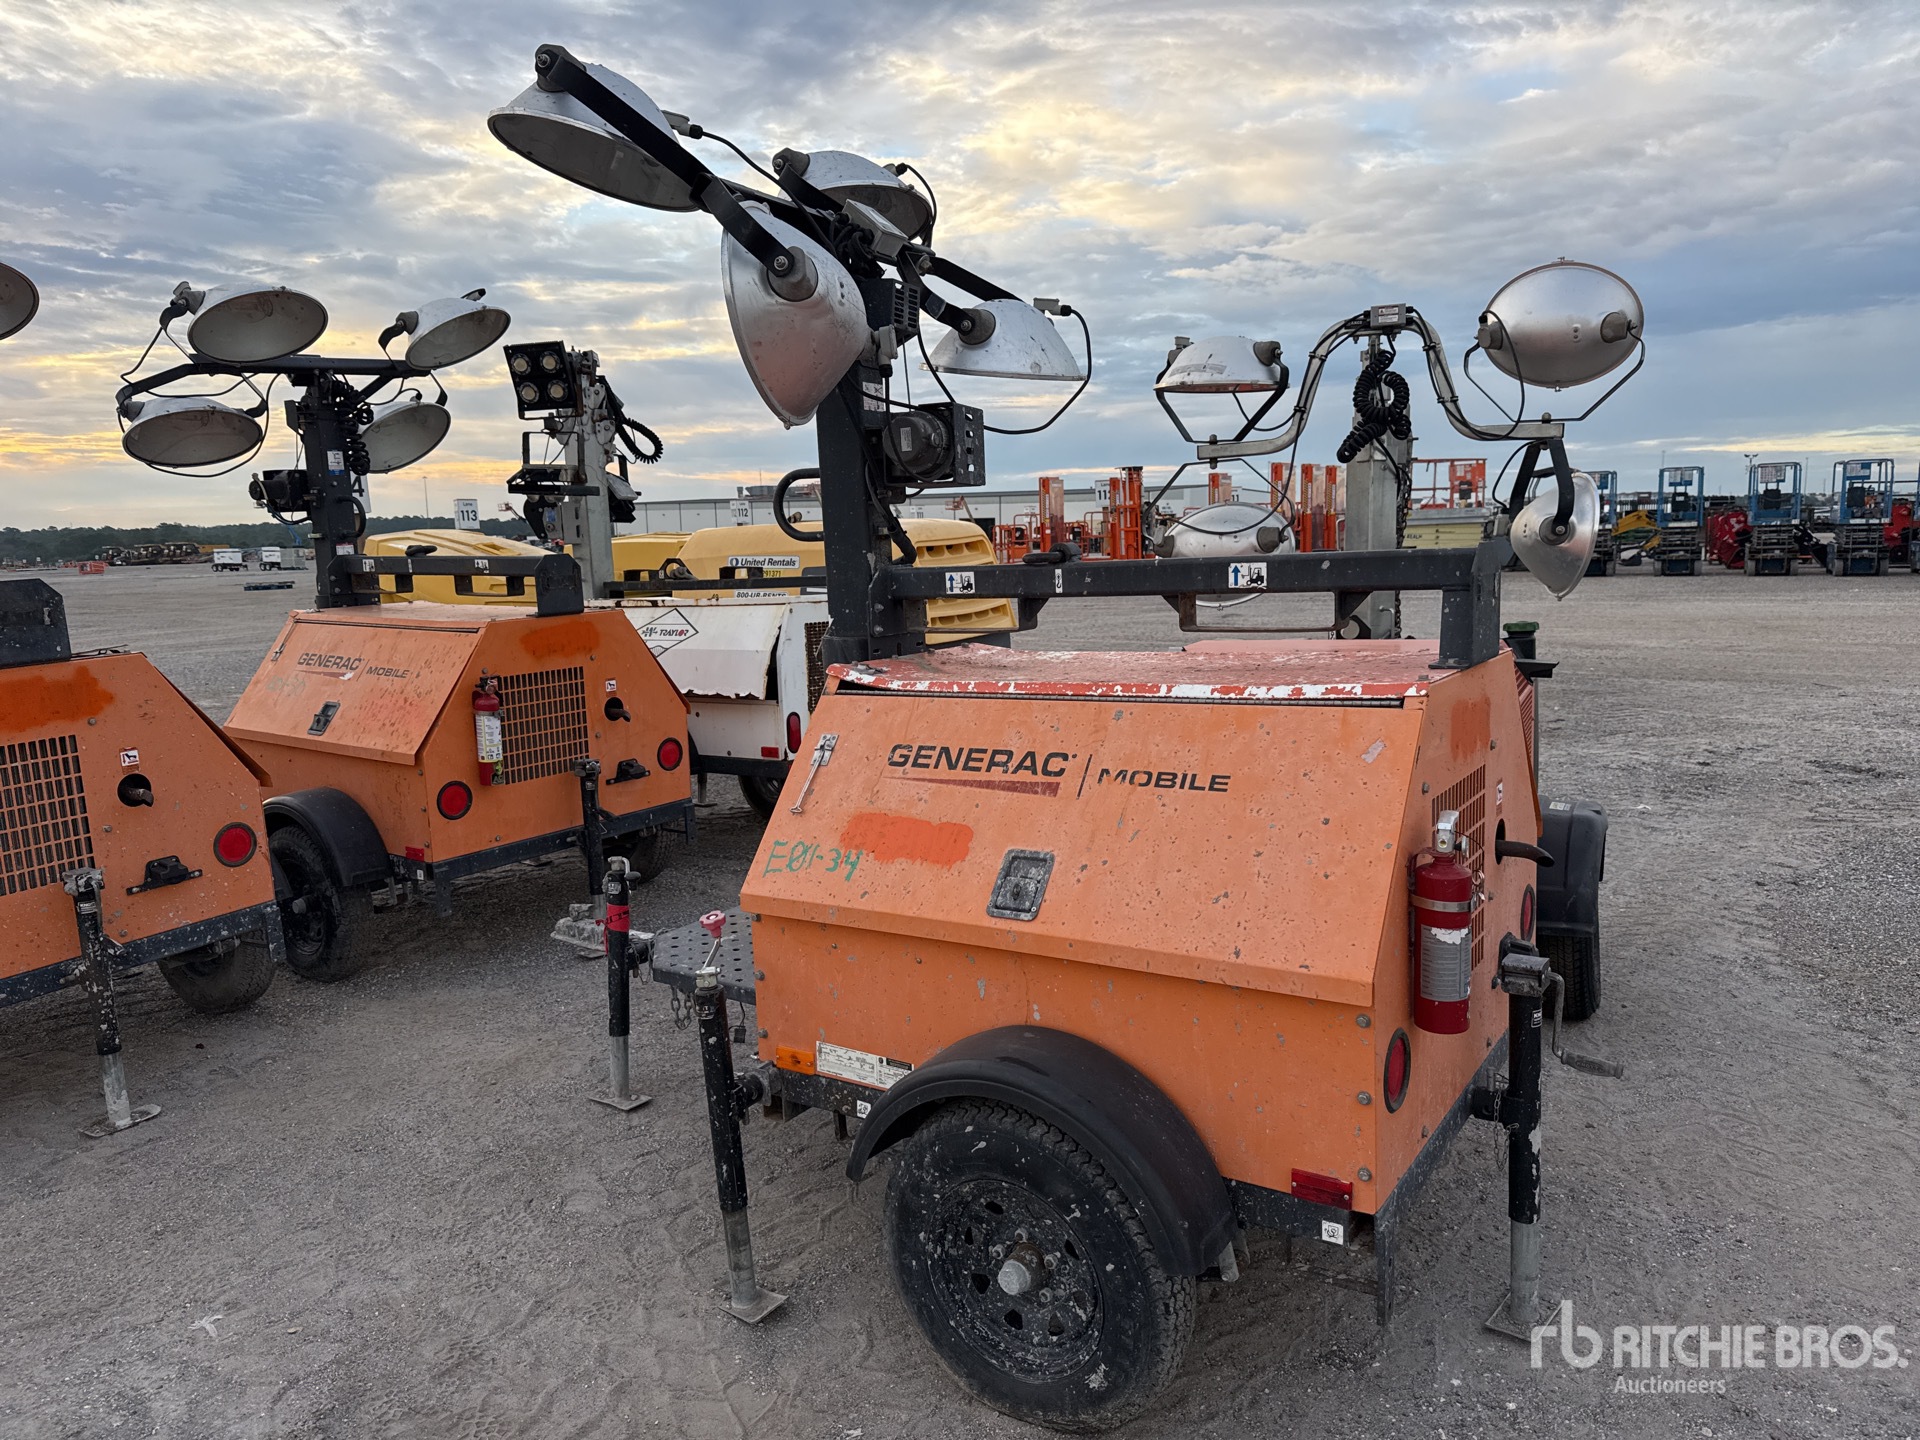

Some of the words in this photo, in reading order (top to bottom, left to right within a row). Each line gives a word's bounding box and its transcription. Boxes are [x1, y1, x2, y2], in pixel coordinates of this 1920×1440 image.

[460, 509, 478, 522] 113
[737, 508, 749, 518] 112
[740, 557, 766, 567] United
[767, 557, 797, 568] Rentals
[659, 628, 690, 637] TRAYLOR
[296, 652, 363, 672] GENERAC
[366, 665, 411, 679] MOBILE
[887, 743, 1071, 778] GENERAC
[1097, 767, 1233, 793] MOBILE
